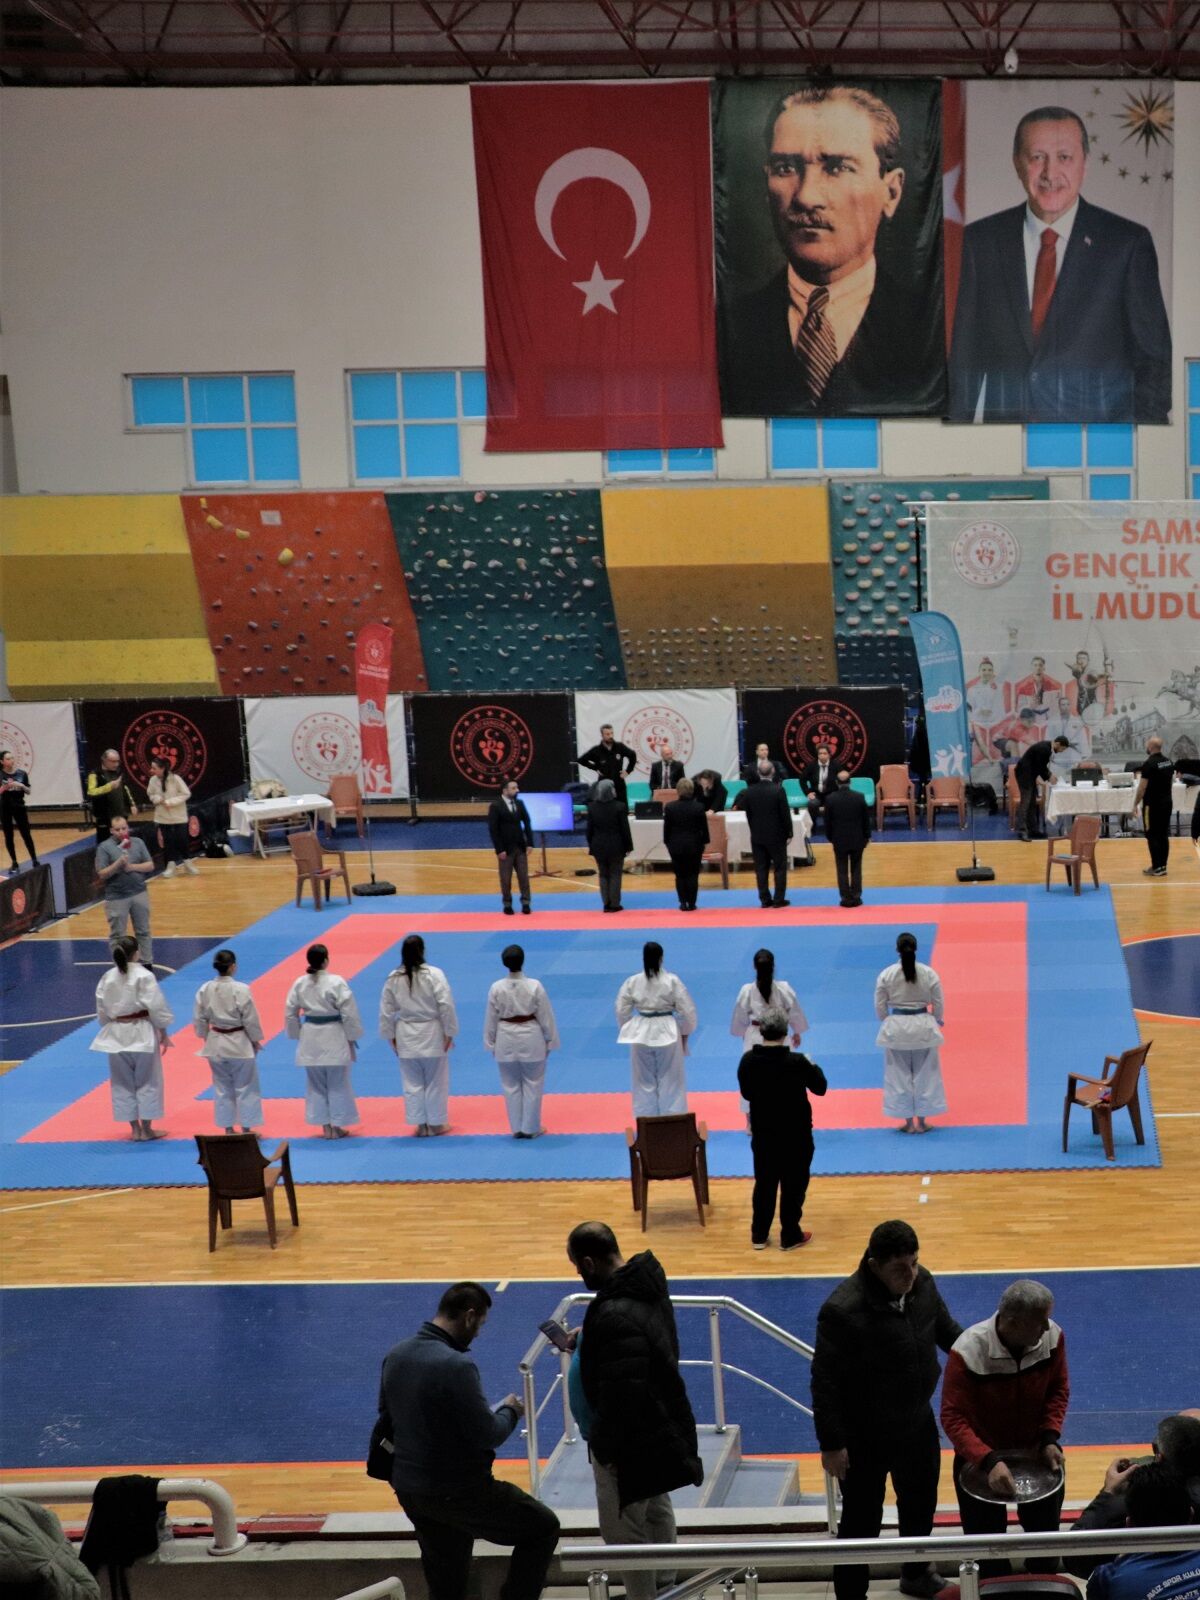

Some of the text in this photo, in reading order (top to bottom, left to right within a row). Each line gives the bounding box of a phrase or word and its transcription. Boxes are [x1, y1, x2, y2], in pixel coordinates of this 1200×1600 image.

[1045, 545, 1193, 585] GENÇLİK
[1053, 583, 1083, 620] İL
[1163, 1575, 1182, 1587] SPOR
